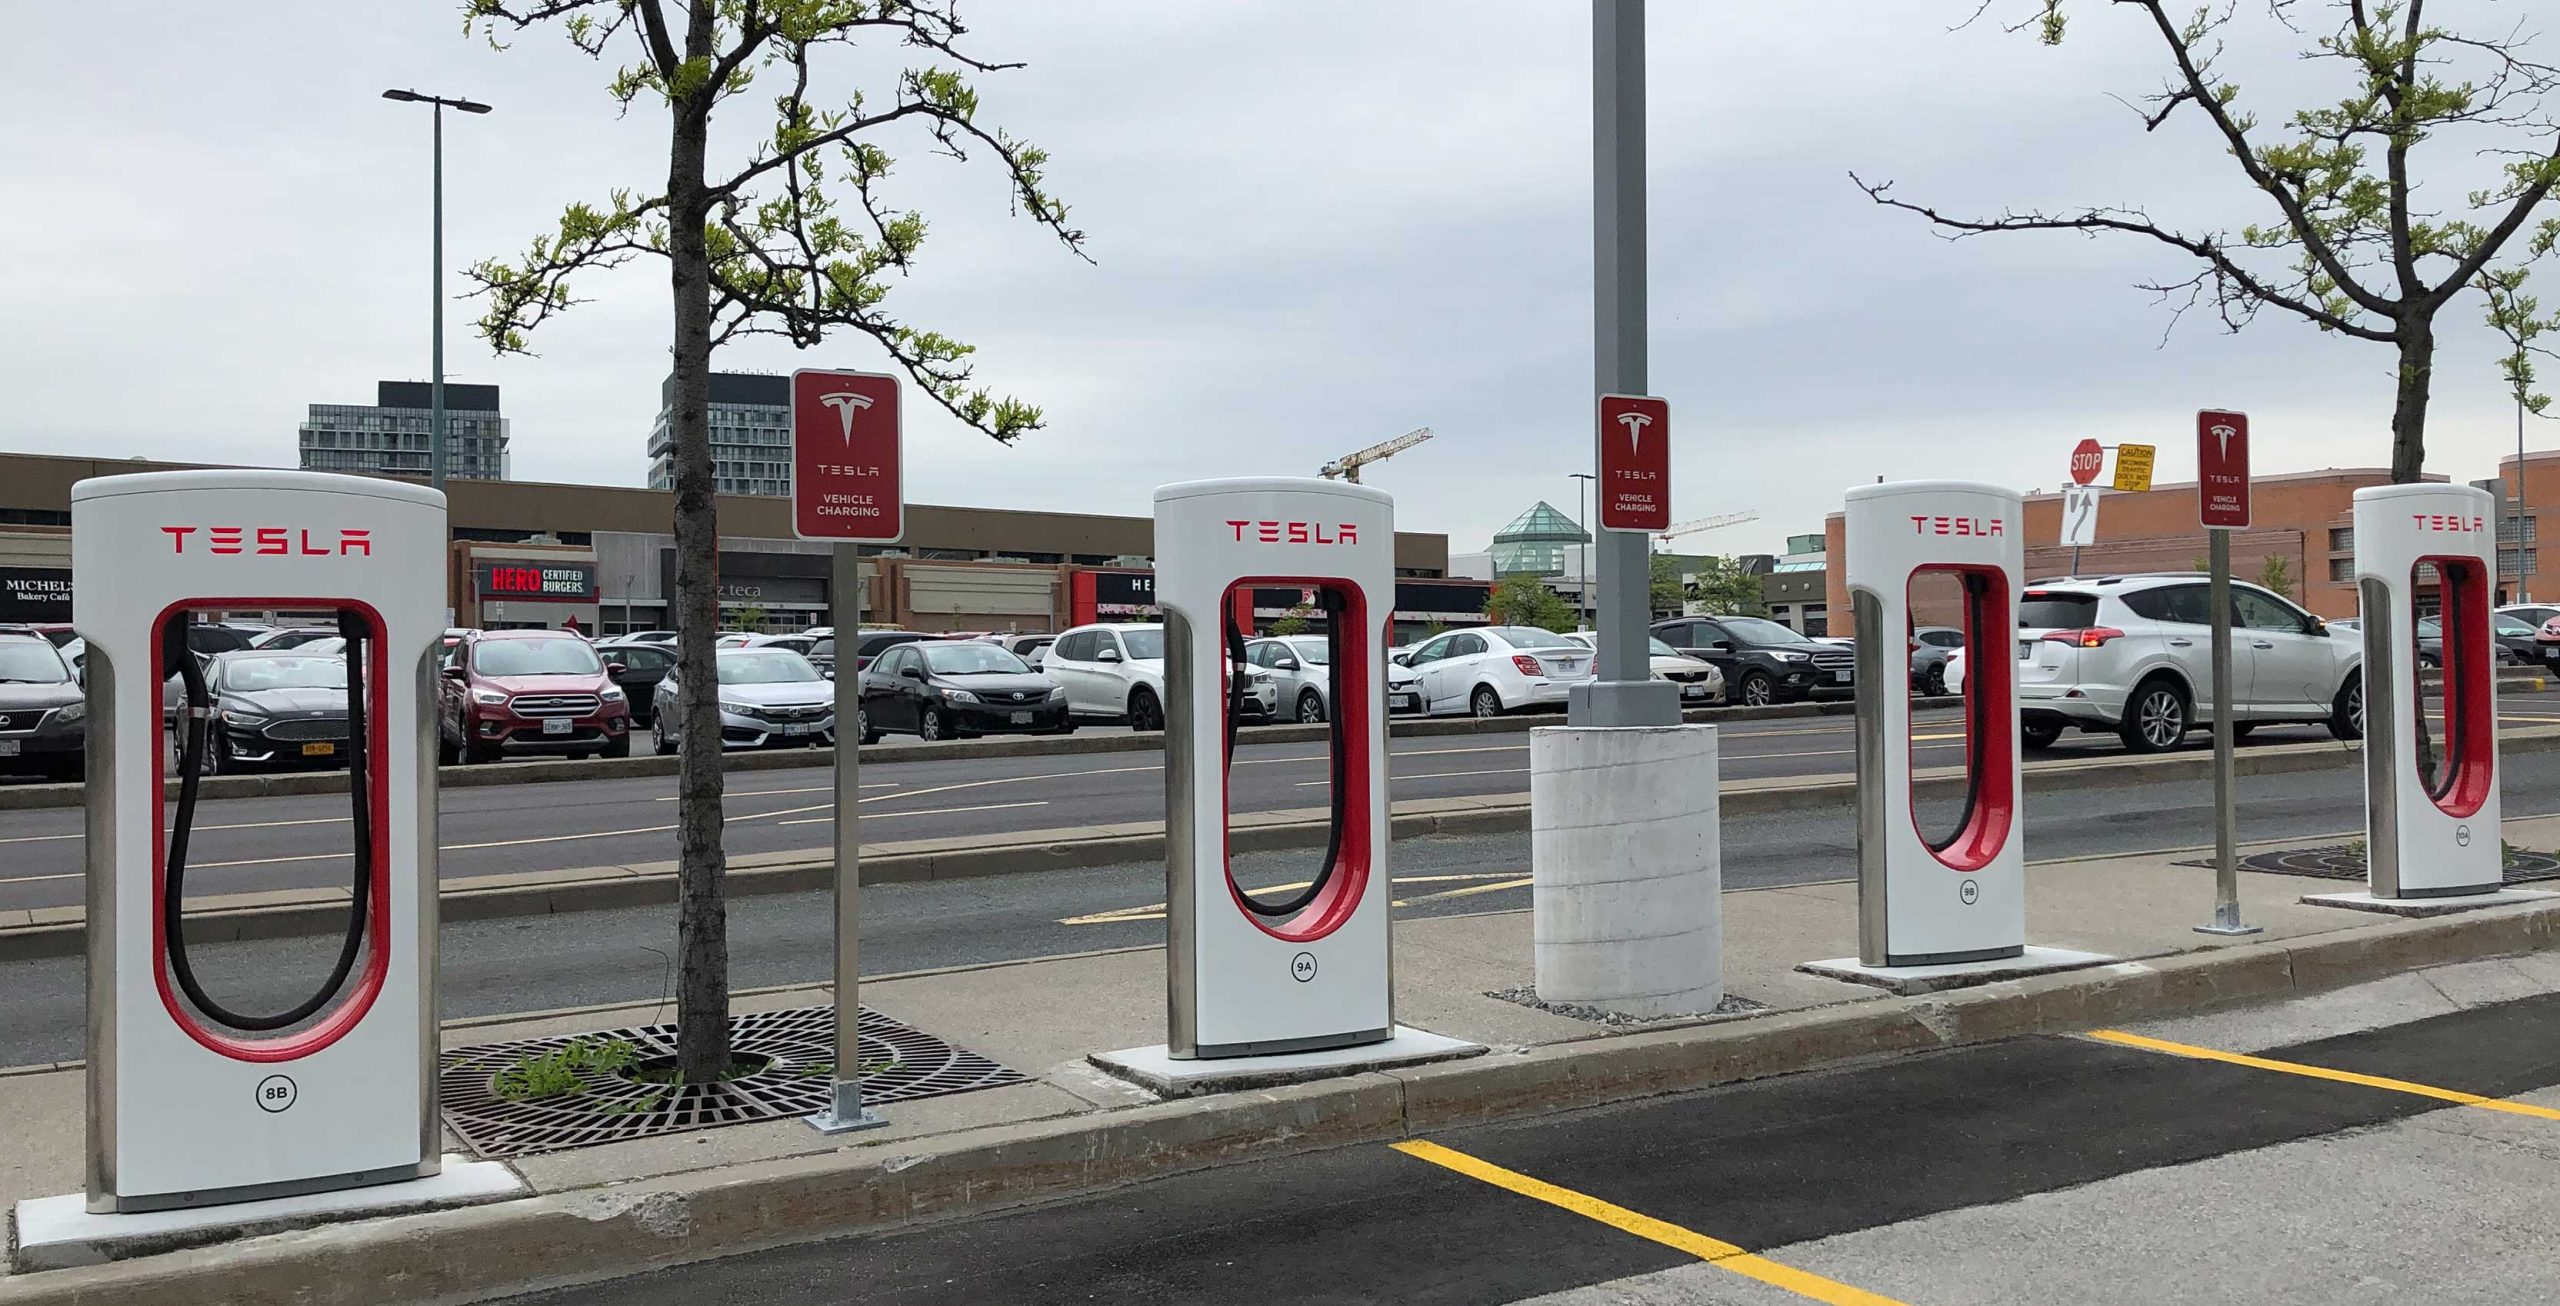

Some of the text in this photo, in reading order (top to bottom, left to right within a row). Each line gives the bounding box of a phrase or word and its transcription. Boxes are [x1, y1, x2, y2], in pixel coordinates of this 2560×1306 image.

[2120, 446, 2152, 458] CAUTION
[2072, 453, 2101, 471] STOP
[817, 464, 879, 477] TESLA
[1615, 470, 1656, 480] TESLA
[2209, 474, 2240, 484] TESLA
[823, 494, 874, 505] VEHICLE
[1619, 493, 1653, 503] VEHICLE
[2212, 495, 2238, 504] VEHICLE
[817, 505, 880, 517] CHARGING
[1615, 503, 1657, 513] CHARGING
[2209, 503, 2241, 512] CHARGING
[1910, 516, 2003, 537] TESLA
[2412, 515, 2483, 533] TESLA
[1226, 520, 1357, 545] TESLA
[160, 526, 371, 556] TESLA
[492, 567, 540, 592] HERO
[542, 569, 583, 581] CERTIFIED
[17, 592, 48, 603] Bakery
[1297, 962, 1312, 972] 9A
[266, 1087, 288, 1100] 8B
